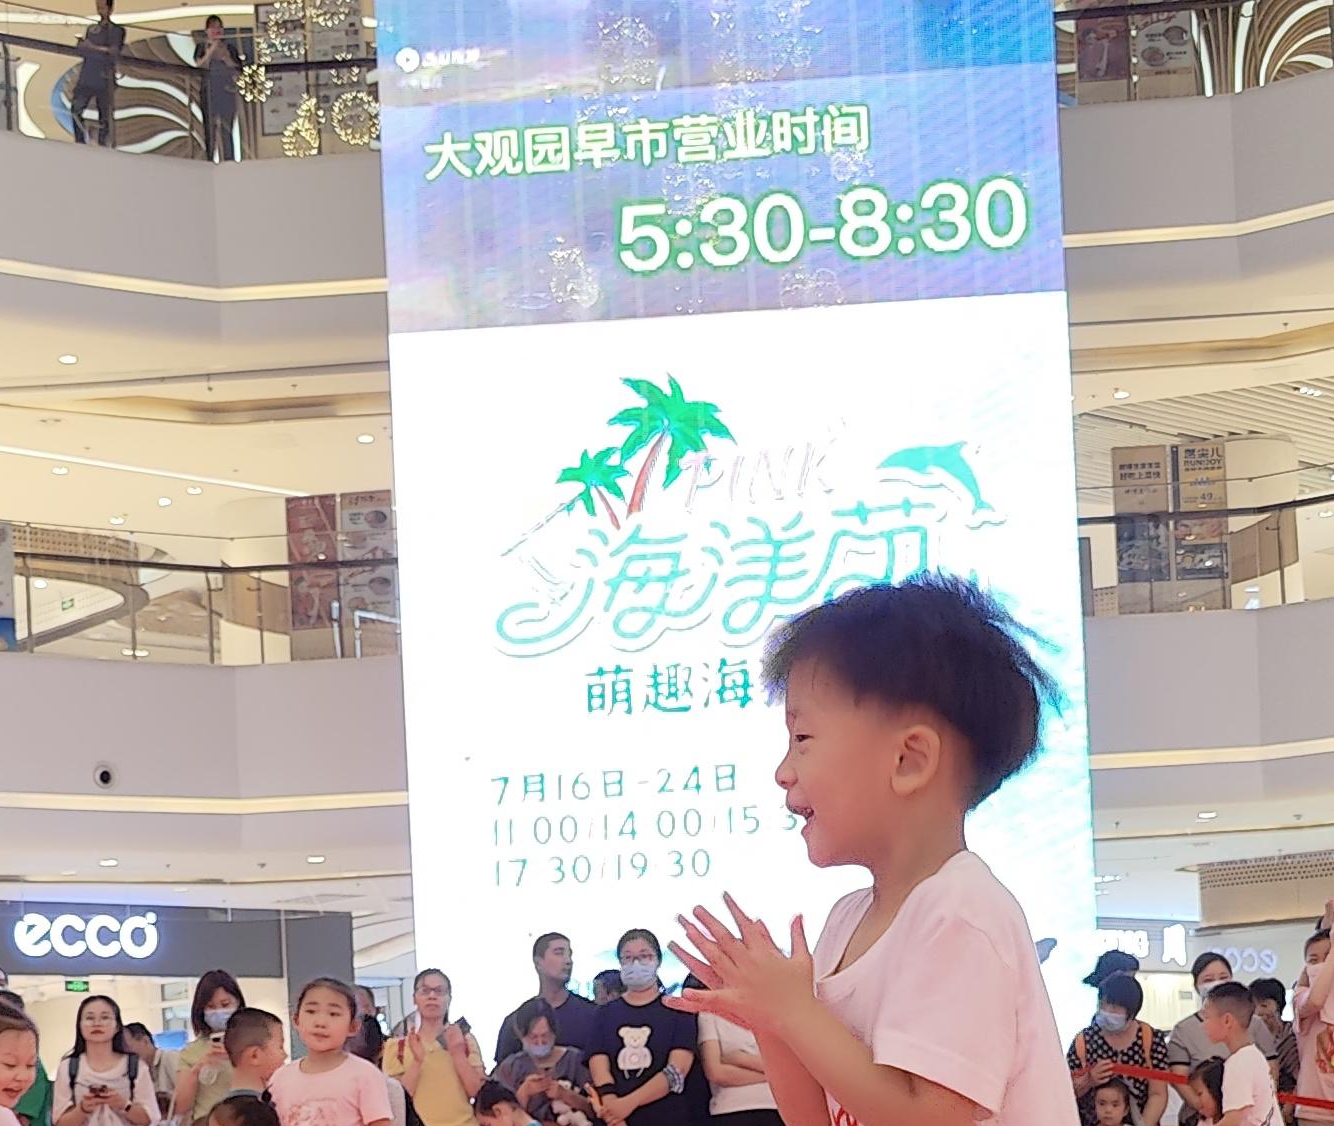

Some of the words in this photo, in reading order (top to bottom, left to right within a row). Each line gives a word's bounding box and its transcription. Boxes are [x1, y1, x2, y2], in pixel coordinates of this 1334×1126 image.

[424, 104, 870, 182] 大观园早市营业时间
[618, 178, 1029, 273] 5:30-8:30
[585, 658, 772, 716] 萌趣海
[14, 911, 158, 959] ecco
